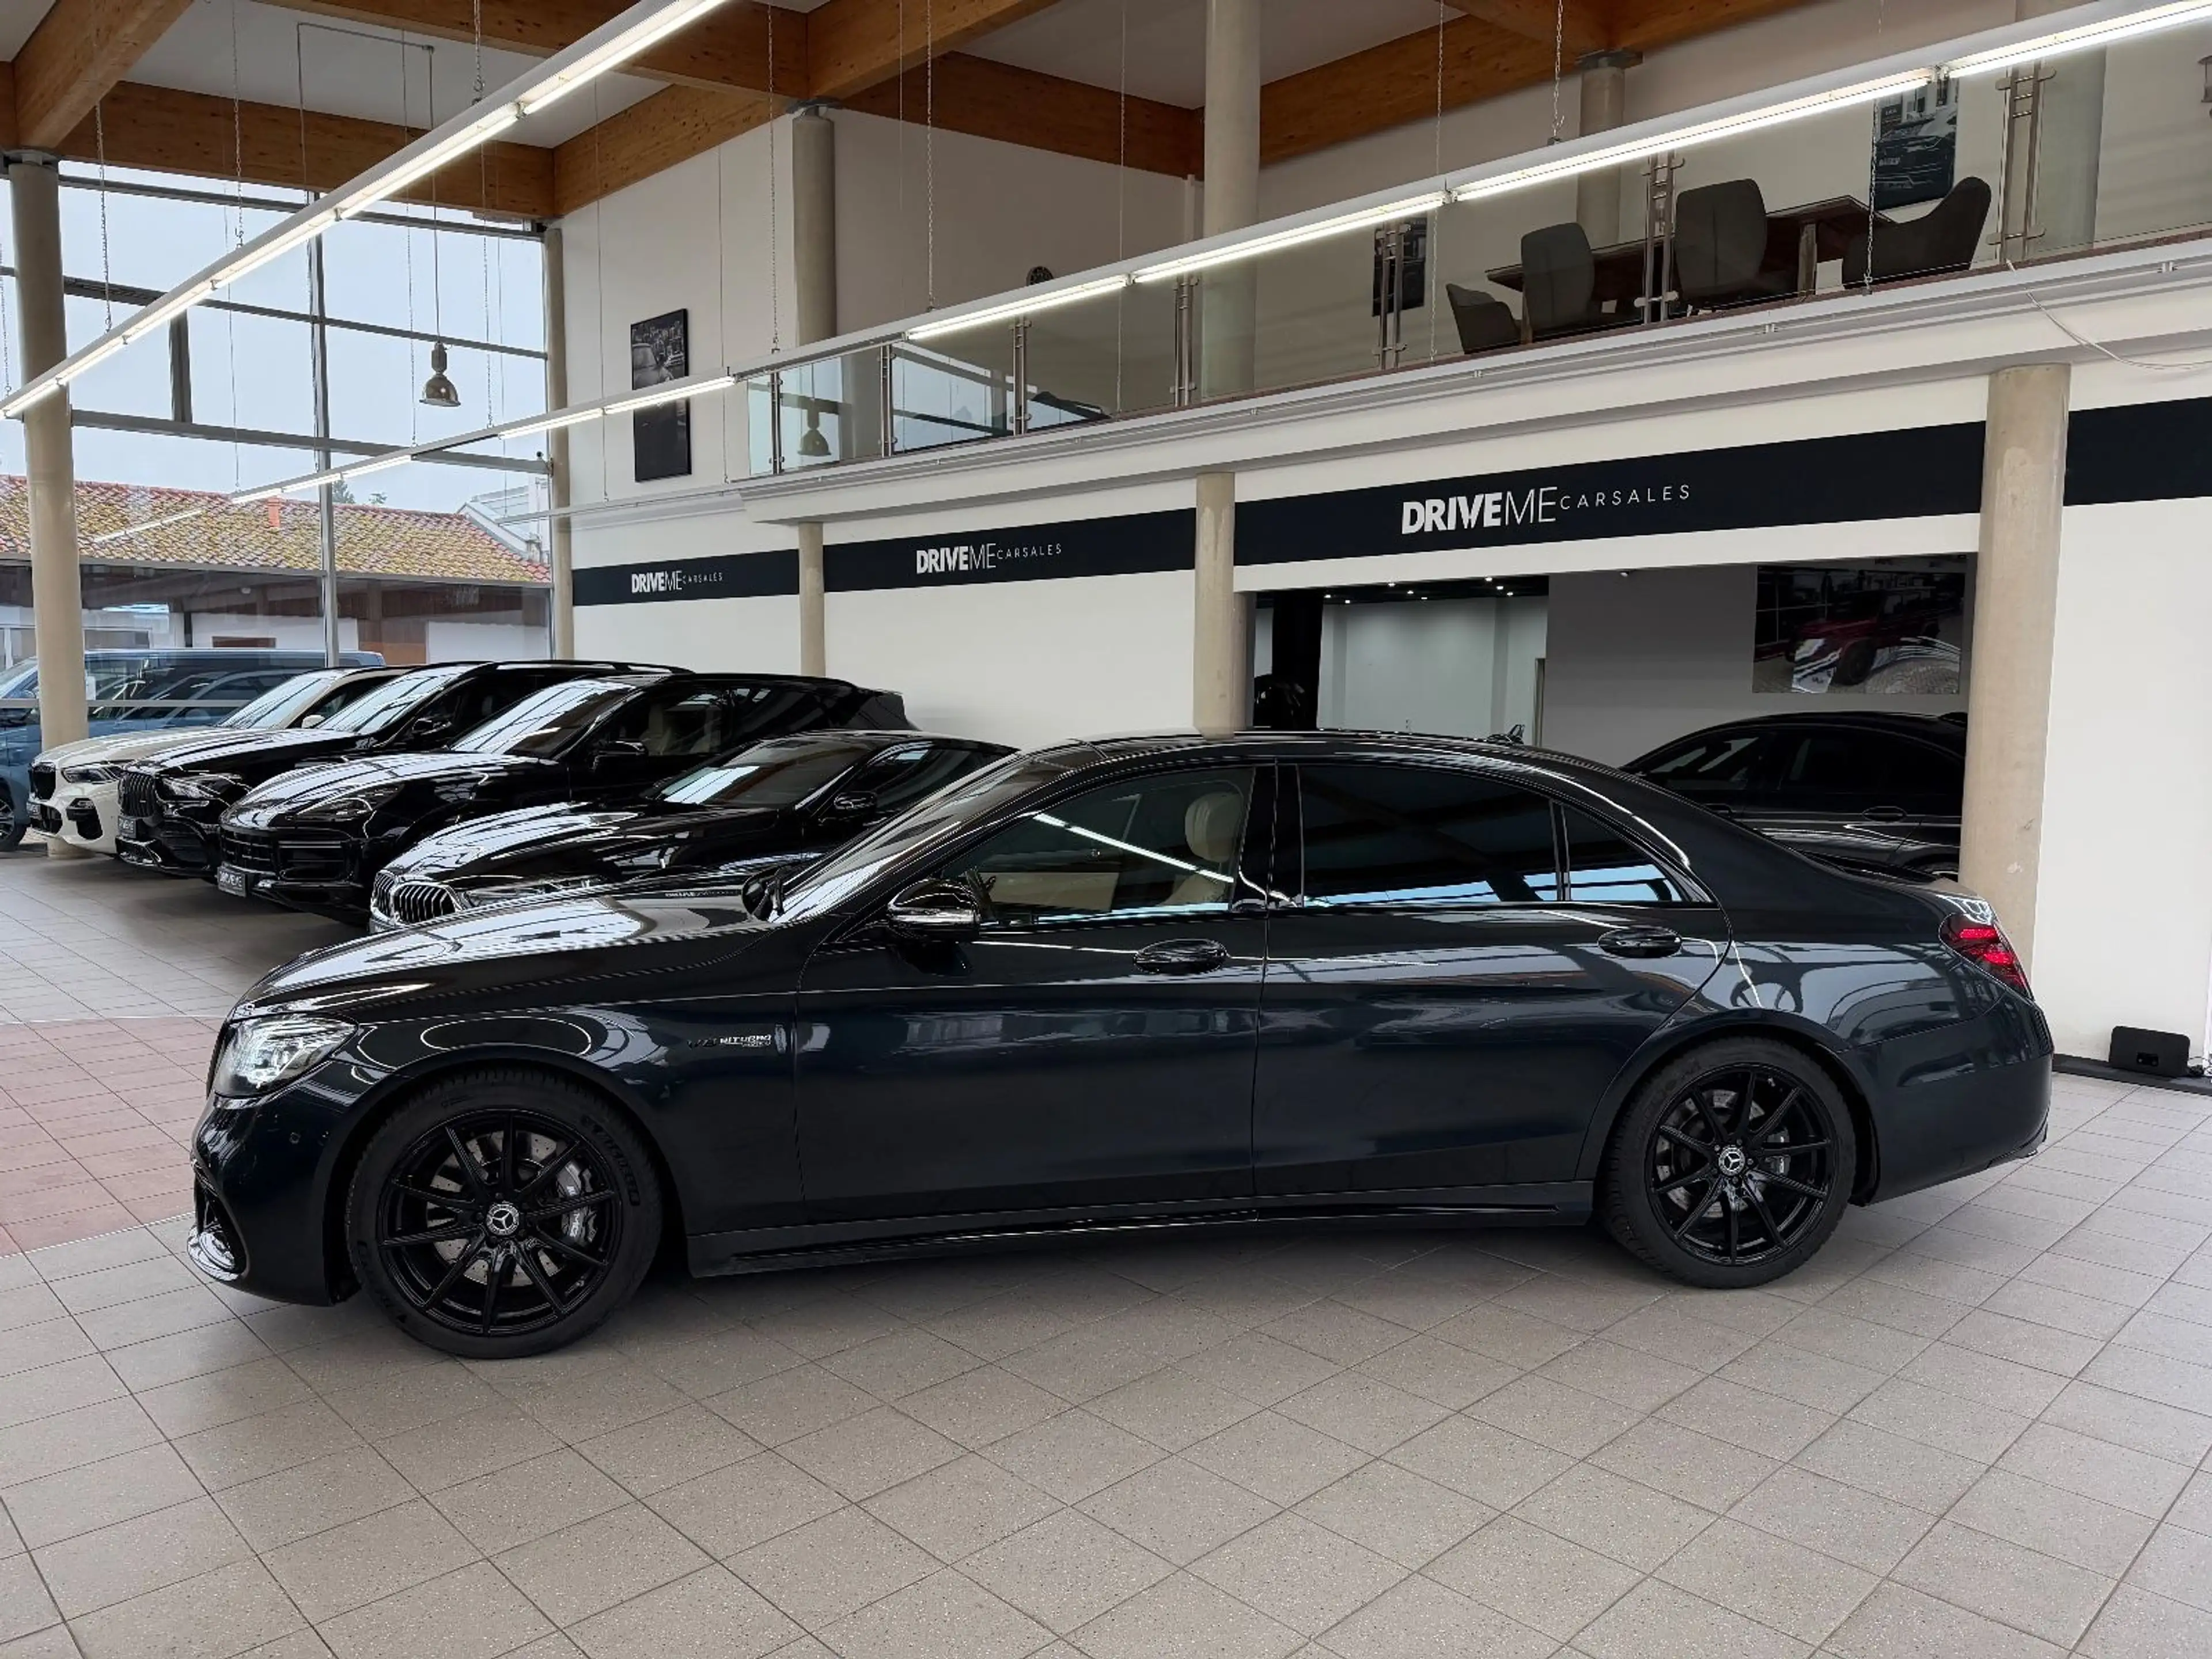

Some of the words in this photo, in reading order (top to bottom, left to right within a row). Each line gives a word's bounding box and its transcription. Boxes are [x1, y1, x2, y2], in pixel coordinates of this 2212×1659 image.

[1402, 487, 1558, 534] DRIVEME
[1560, 484, 1690, 510] CARSALES
[916, 543, 996, 574] DRIVEME
[997, 543, 1062, 560] CARSALES
[631, 570, 683, 593] DRIVEME
[683, 572, 723, 584] CARSALES
